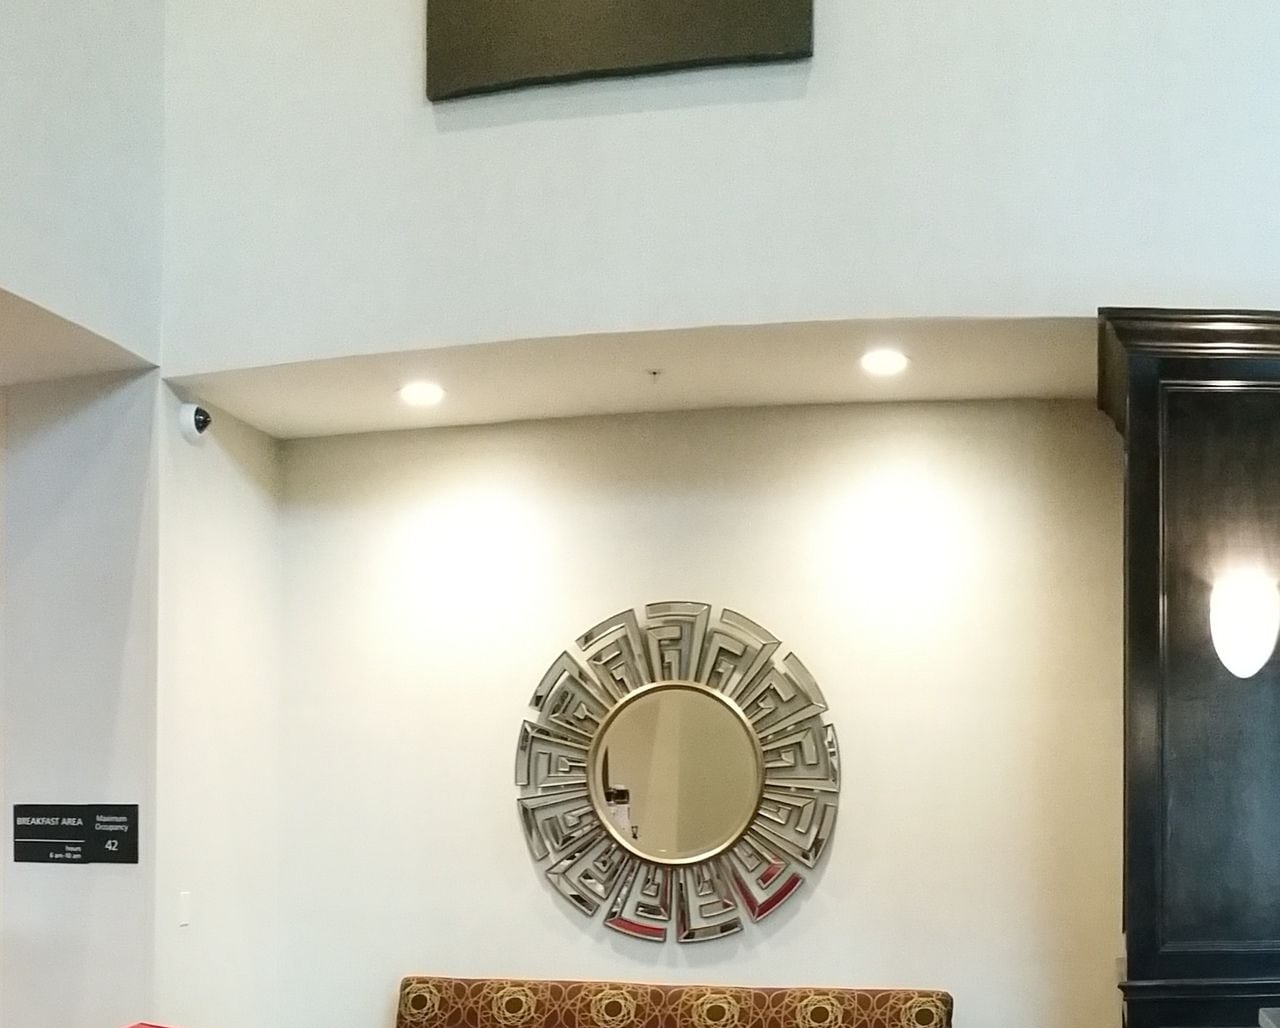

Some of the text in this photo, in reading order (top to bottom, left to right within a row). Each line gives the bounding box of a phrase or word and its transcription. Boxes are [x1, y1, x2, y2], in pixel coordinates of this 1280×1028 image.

[16, 817, 83, 826] BREAKFAST AREA
[95, 823, 129, 832] Occupancy
[104, 840, 119, 851] 42
